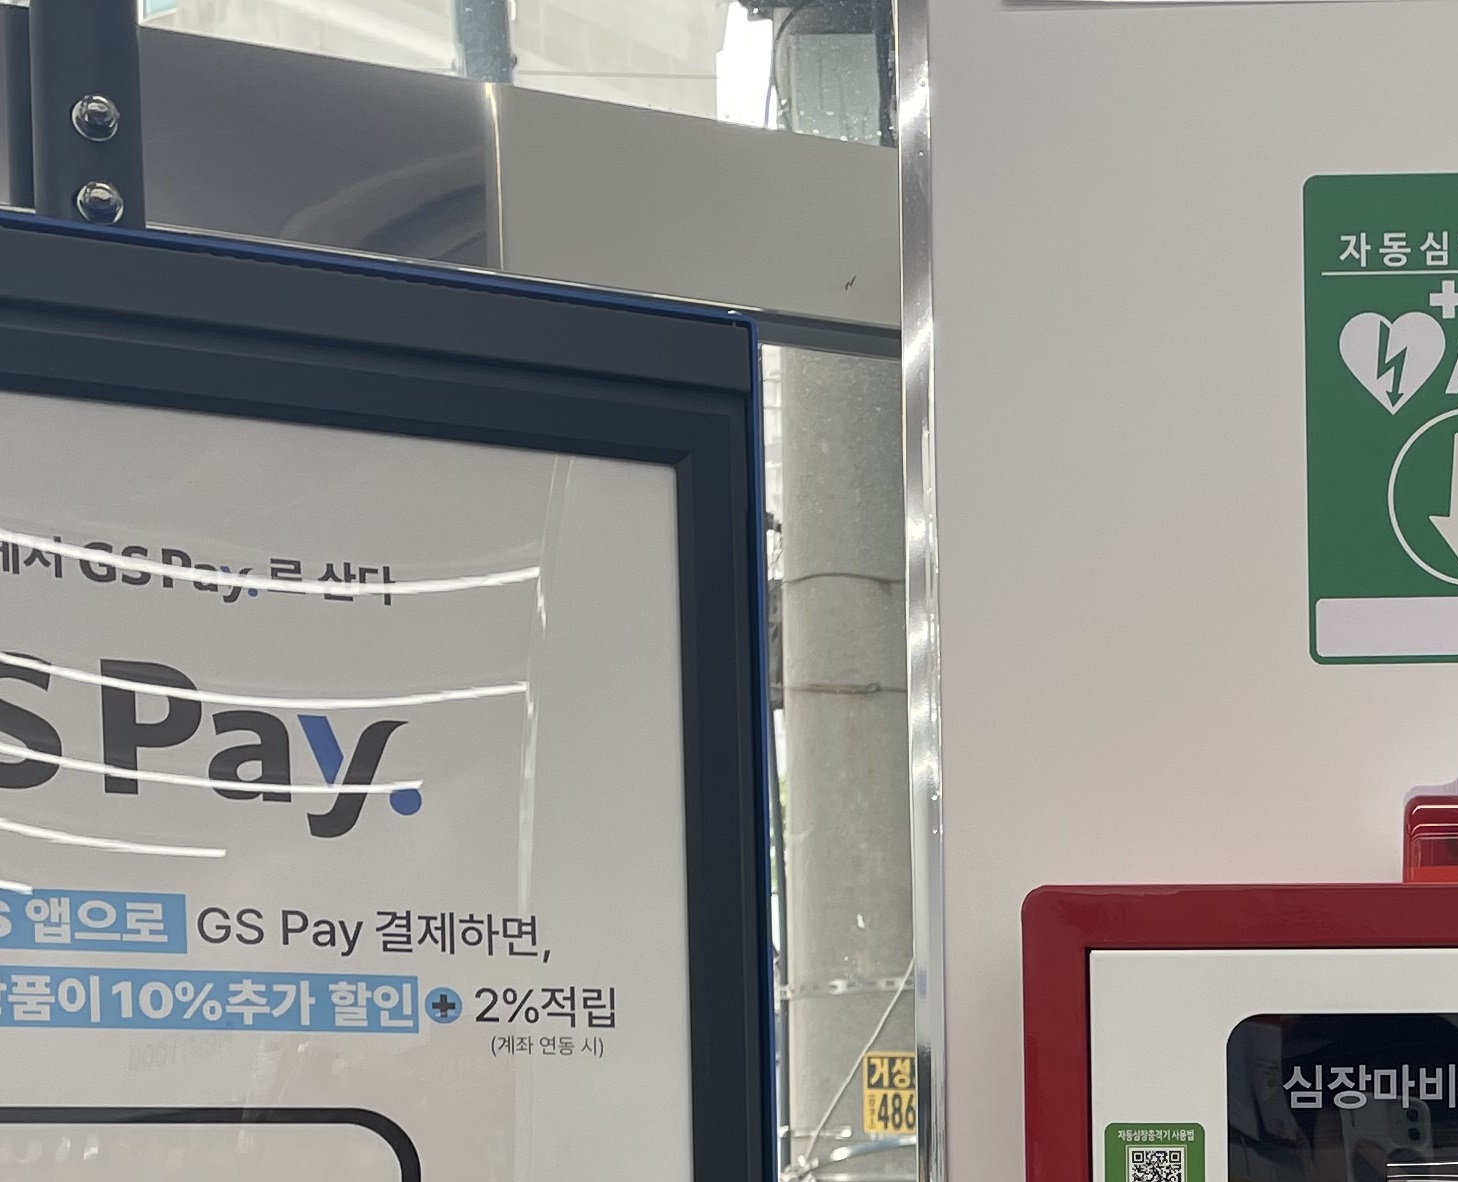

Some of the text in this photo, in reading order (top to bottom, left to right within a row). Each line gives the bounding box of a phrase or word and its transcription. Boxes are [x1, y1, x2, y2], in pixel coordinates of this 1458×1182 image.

[79, 541, 153, 587] GS
[317, 561, 397, 606] 산다
[100, 658, 422, 838] Pay.
[25, 897, 168, 944] 앱으로
[197, 907, 265, 946] GS
[280, 910, 364, 956] Pay
[375, 910, 552, 963] 결제하면,
[111, 979, 315, 1027] 10%추가
[329, 980, 415, 1029] 할인
[474, 986, 617, 1029] 2%적립
[491, 1034, 604, 1058] (계좌 연동 시)
[877, 1093, 916, 1131] 486
[1117, 1129, 1171, 1142] 자동심장충격기
